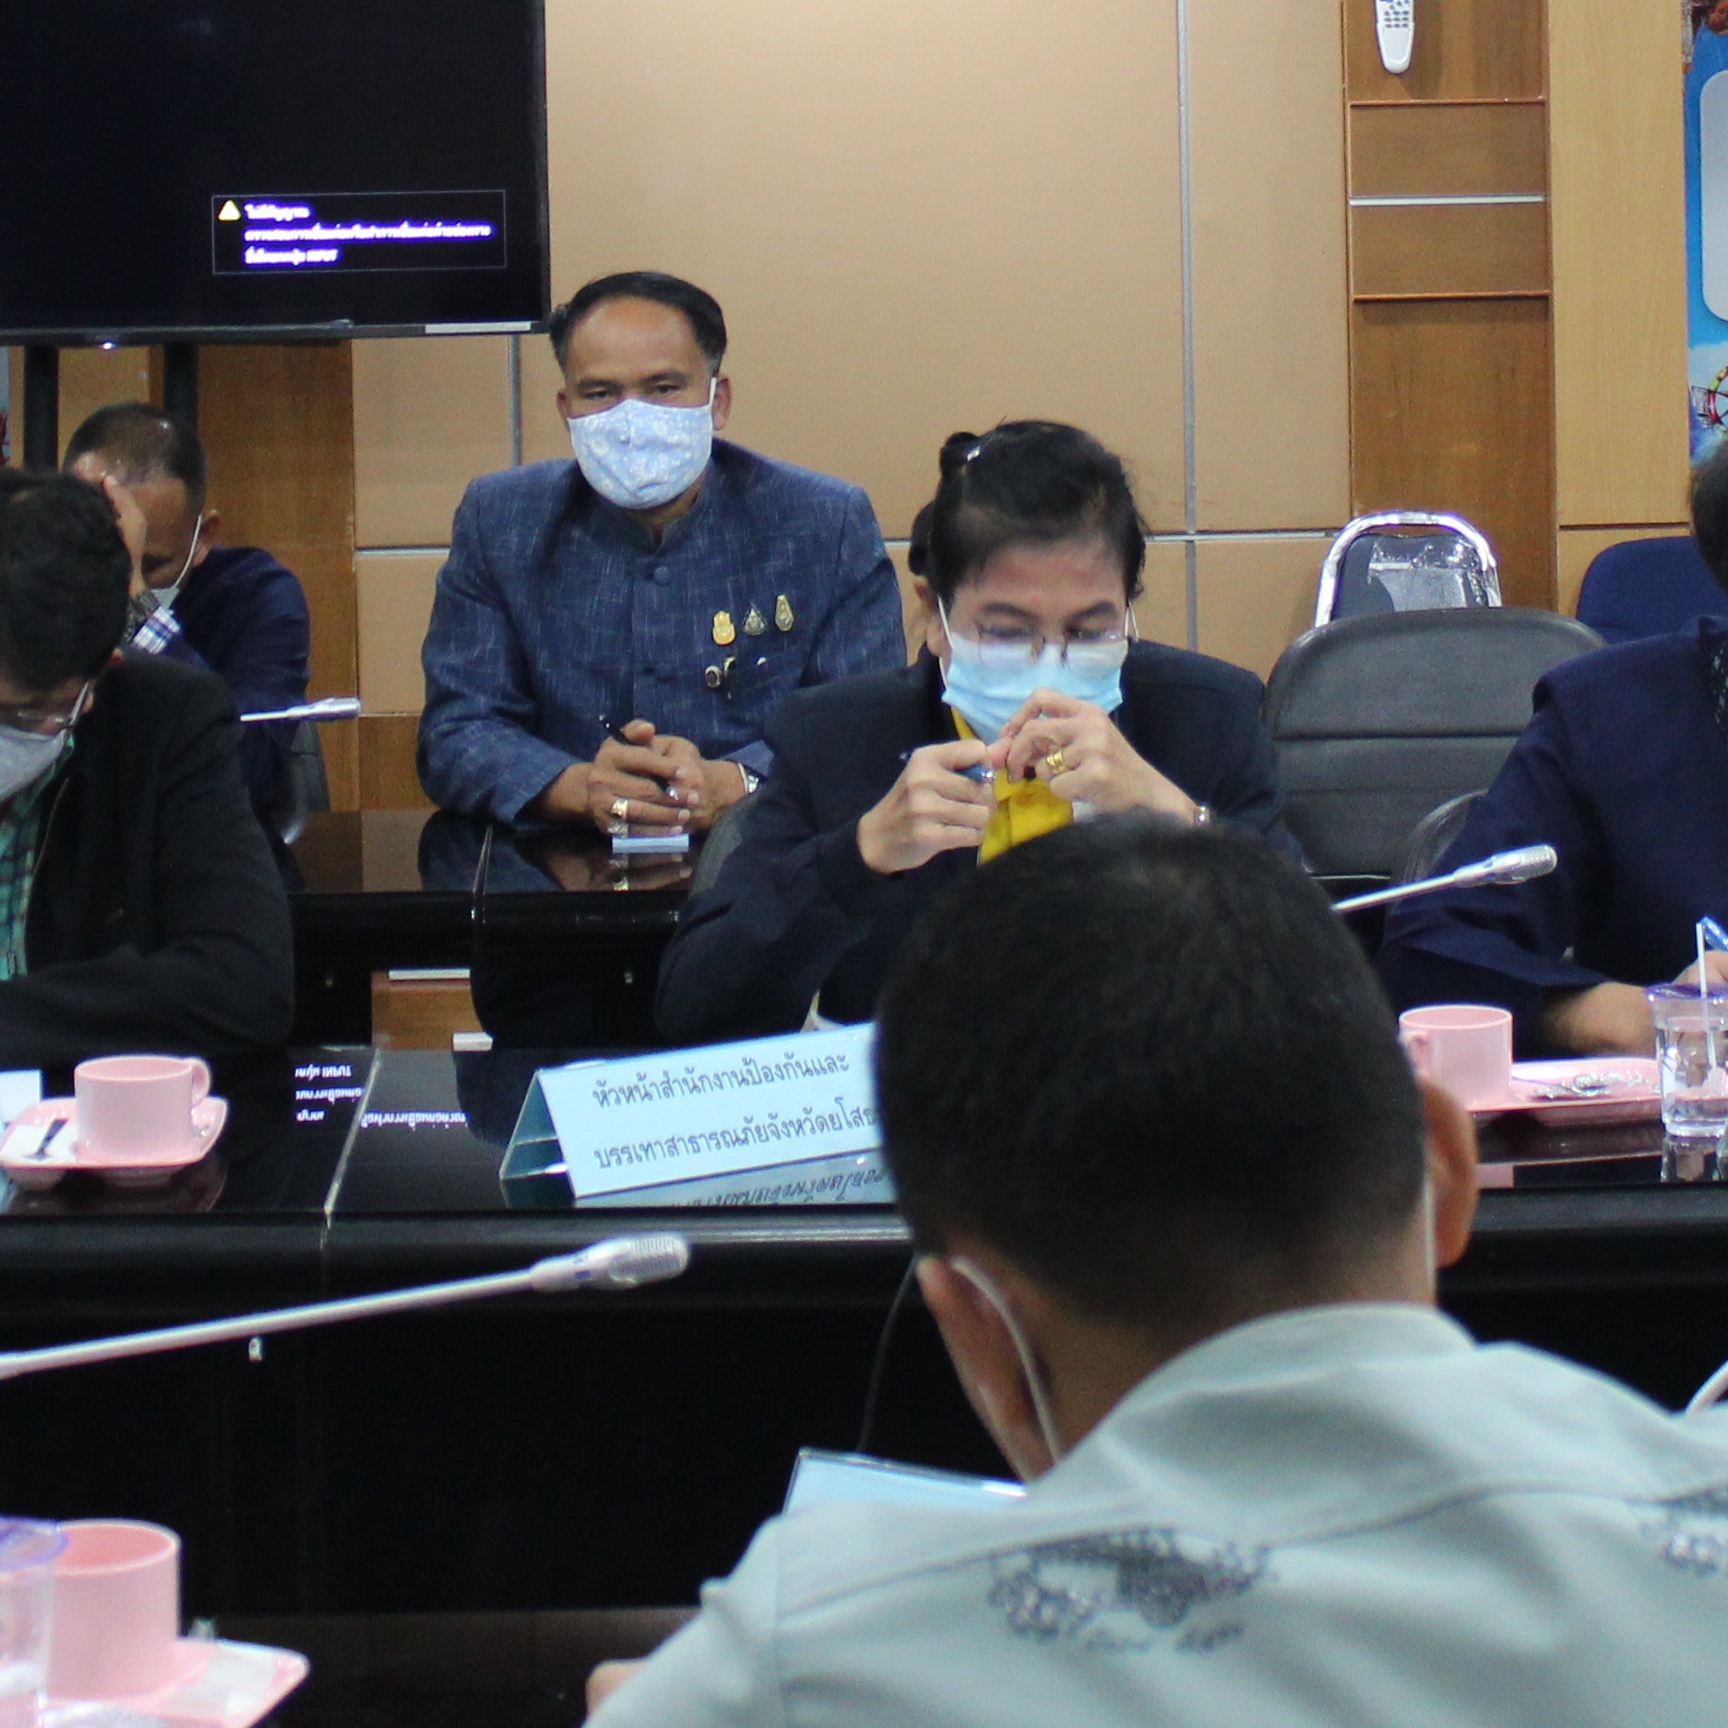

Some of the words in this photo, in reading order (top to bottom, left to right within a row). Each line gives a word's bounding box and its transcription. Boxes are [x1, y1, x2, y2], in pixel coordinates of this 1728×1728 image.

[591, 1051, 850, 1109] หัวหน้าสำนักงานป้องกันและ
[593, 1096, 878, 1170] บรรเทาสาธารณภัยจังหวัดยโสธ
